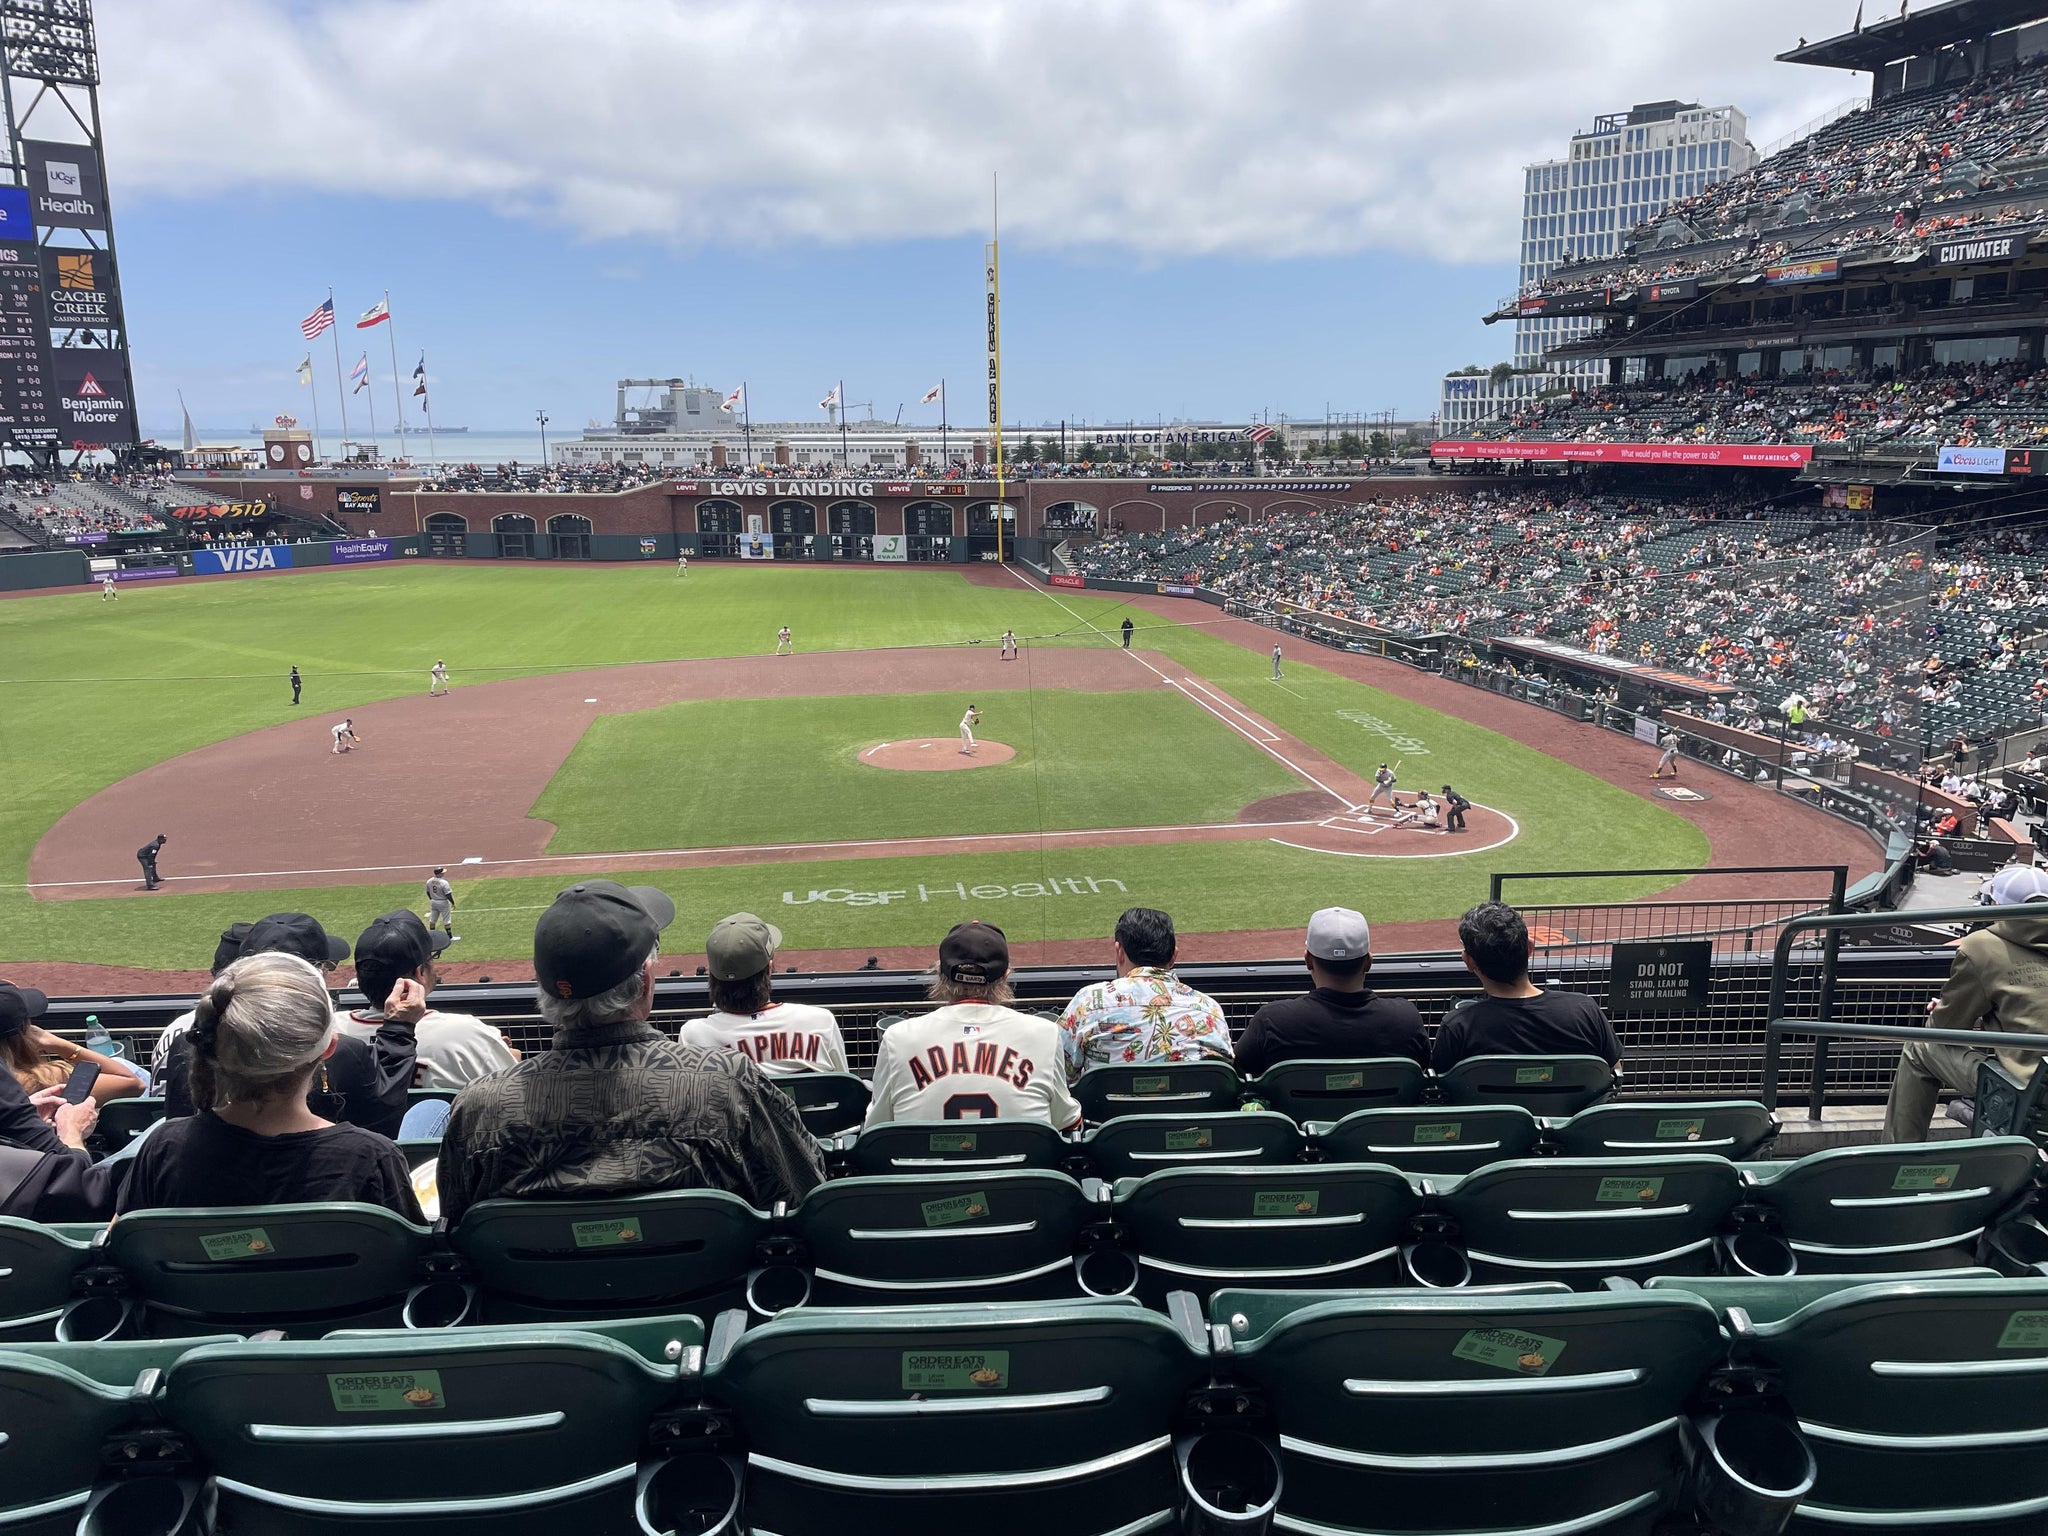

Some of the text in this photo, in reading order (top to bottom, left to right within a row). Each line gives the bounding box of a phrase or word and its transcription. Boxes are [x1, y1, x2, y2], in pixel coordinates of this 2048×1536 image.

[50, 171, 77, 185] UCSF
[39, 197, 95, 215] Health
[1940, 240, 2011, 263] CUTWATER
[51, 290, 107, 303] CACHE
[1660, 286, 1680, 296] TOYOTA
[54, 303, 107, 315] CREEK
[1446, 379, 1478, 392] VISA
[61, 397, 124, 412] Benjamin
[73, 411, 118, 423] Moore
[275, 415, 297, 424] Coors
[1096, 432, 1238, 444] BANK OF AMERICA
[72, 440, 133, 451] Coors LIGHT
[1620, 449, 1635, 458] What
[1635, 450, 1650, 459] would
[1651, 452, 1661, 460] you
[1661, 450, 1671, 459] like
[1671, 451, 1682, 459] the
[1682, 452, 1700, 460] power
[1709, 451, 1721, 460] do?
[1952, 453, 2000, 466] Coors LIGHT
[2023, 450, 2031, 465] 1
[774, 482, 874, 497] LANDING
[350, 491, 379, 503] Sports
[172, 503, 267, 519] 415 510
[205, 541, 248, 550] WELCOME
[256, 539, 266, 547] TO
[296, 537, 312, 545] 415
[335, 543, 388, 554] HealthEquity
[404, 547, 419, 555] 415
[679, 547, 695, 556] 365
[981, 552, 999, 560] 309
[213, 547, 276, 572] VISA
[1054, 577, 1080, 586] ORACLE
[782, 875, 1129, 907] UCSF Health
[1873, 932, 1888, 940] Audi
[1638, 962, 1684, 977] DO NOT
[1629, 979, 1690, 989] STAND, LEAN OR
[1630, 989, 1687, 999] SIT ON RAILING
[724, 1032, 822, 1064] APMAN
[908, 1041, 1035, 1092] ADAMES
[908, 1355, 986, 1365] ORDER EATS
[334, 1375, 416, 1387] ORDER EATS
